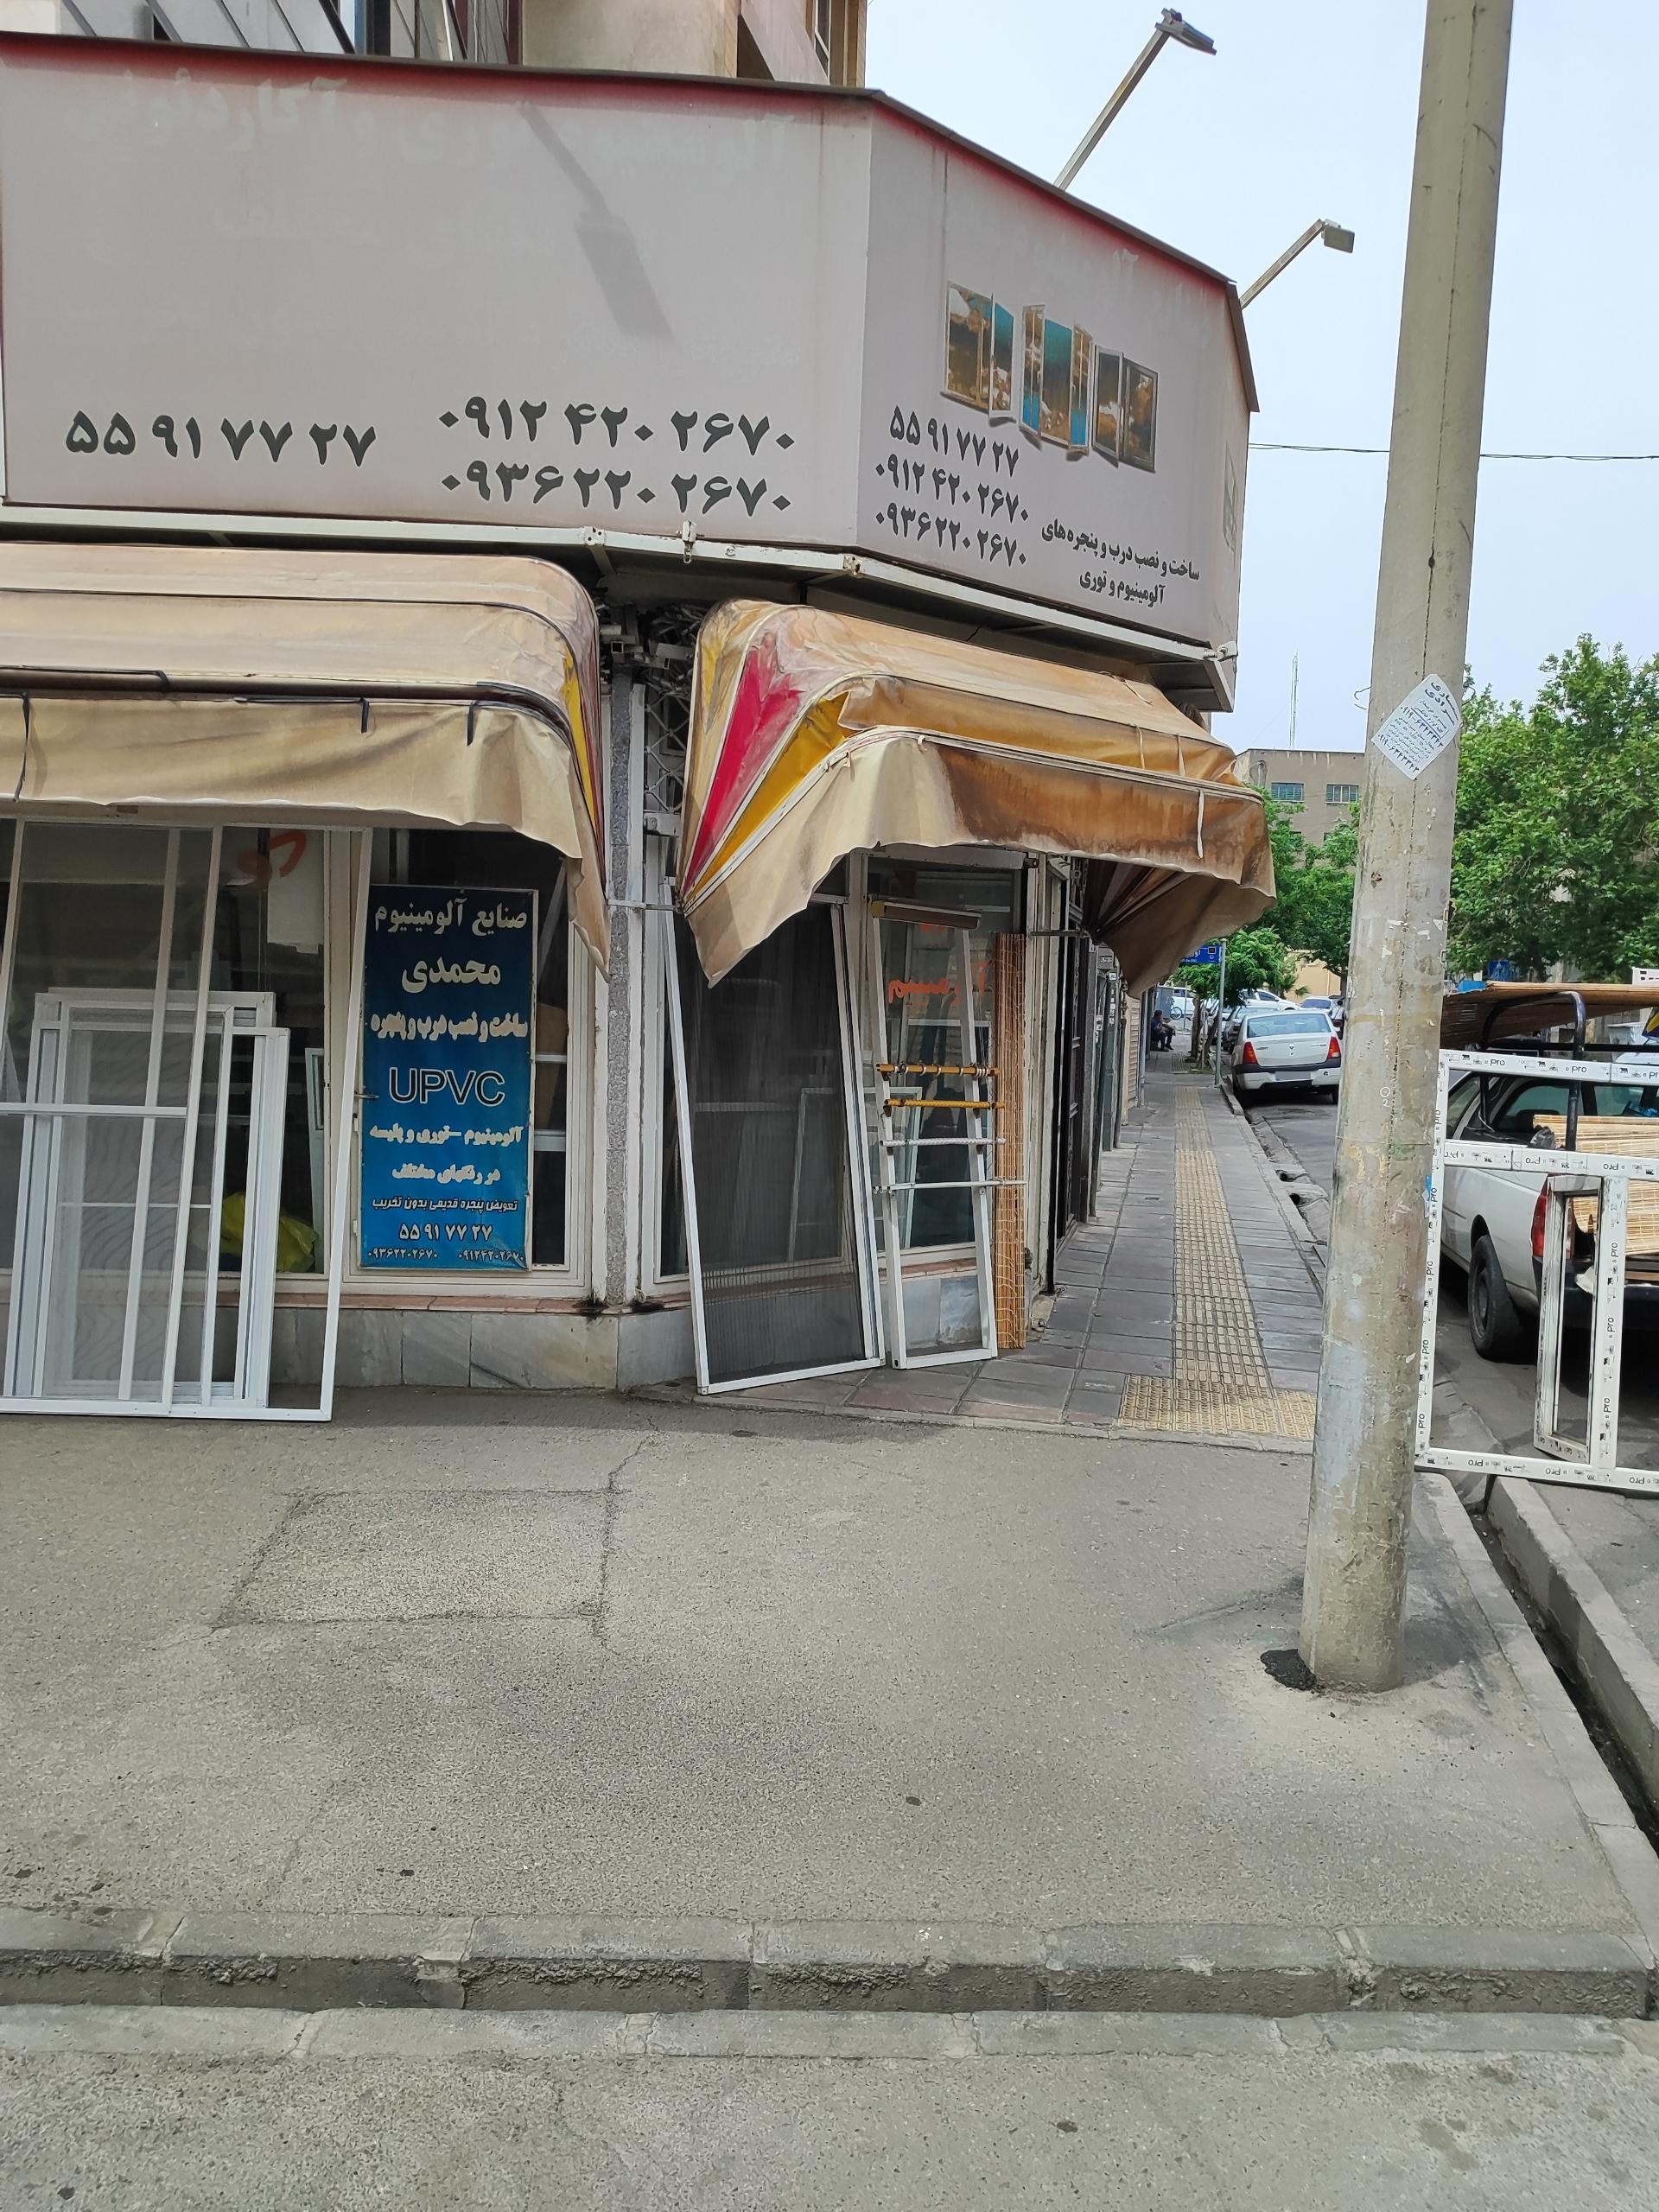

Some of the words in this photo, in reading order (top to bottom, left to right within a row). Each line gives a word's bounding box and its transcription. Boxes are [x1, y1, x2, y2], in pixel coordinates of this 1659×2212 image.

[1099, 541, 1107, 559] و
[1109, 543, 1133, 565] درب
[1135, 550, 1160, 570] نصب
[1160, 560, 1167, 577] و
[1168, 559, 1200, 581] ساخت
[1079, 570, 1107, 593] توری
[1108, 580, 1116, 596] و
[1117, 582, 1166, 607] آلومینیوم
[375, 899, 467, 935] آلومینیوم
[472, 902, 526, 937] صنایع
[402, 957, 501, 994] محمدی
[407, 1017, 416, 1040] و
[416, 1014, 447, 1041] درب
[478, 1020, 488, 1043] و
[489, 1012, 528, 1037] ساخت
[389, 1067, 505, 1107] UPVC
[404, 1128, 415, 1143] و
[464, 1126, 524, 1147] آلومینیوم
[484, 1168, 501, 1185] در
[372, 1197, 402, 1210] تخریب
[404, 1198, 427, 1211] بدون
[429, 1198, 459, 1211] قدیمی
[460, 1199, 484, 1214] پنجره
[486, 1200, 518, 1213] تعویض
